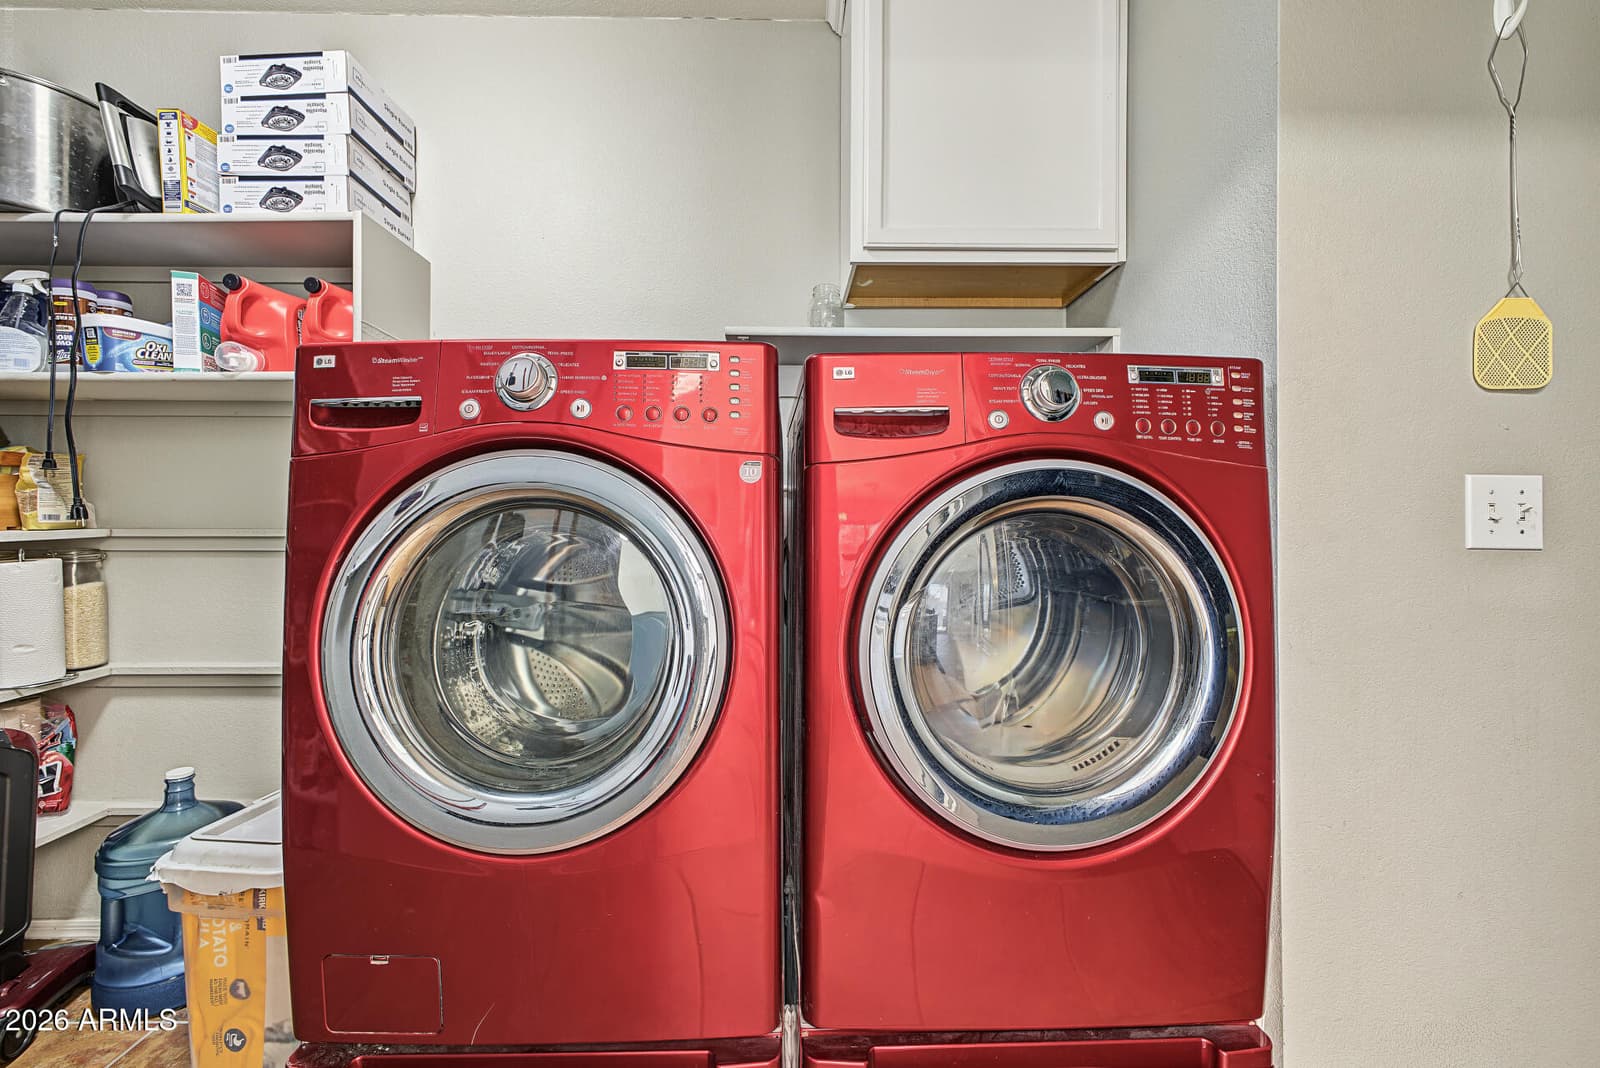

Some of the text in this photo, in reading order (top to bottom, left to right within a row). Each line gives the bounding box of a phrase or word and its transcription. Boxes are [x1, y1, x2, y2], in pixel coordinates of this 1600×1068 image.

[146, 341, 168, 352] OXI
[136, 349, 173, 361] CLEAN
[212, 918, 228, 968] OTATO
